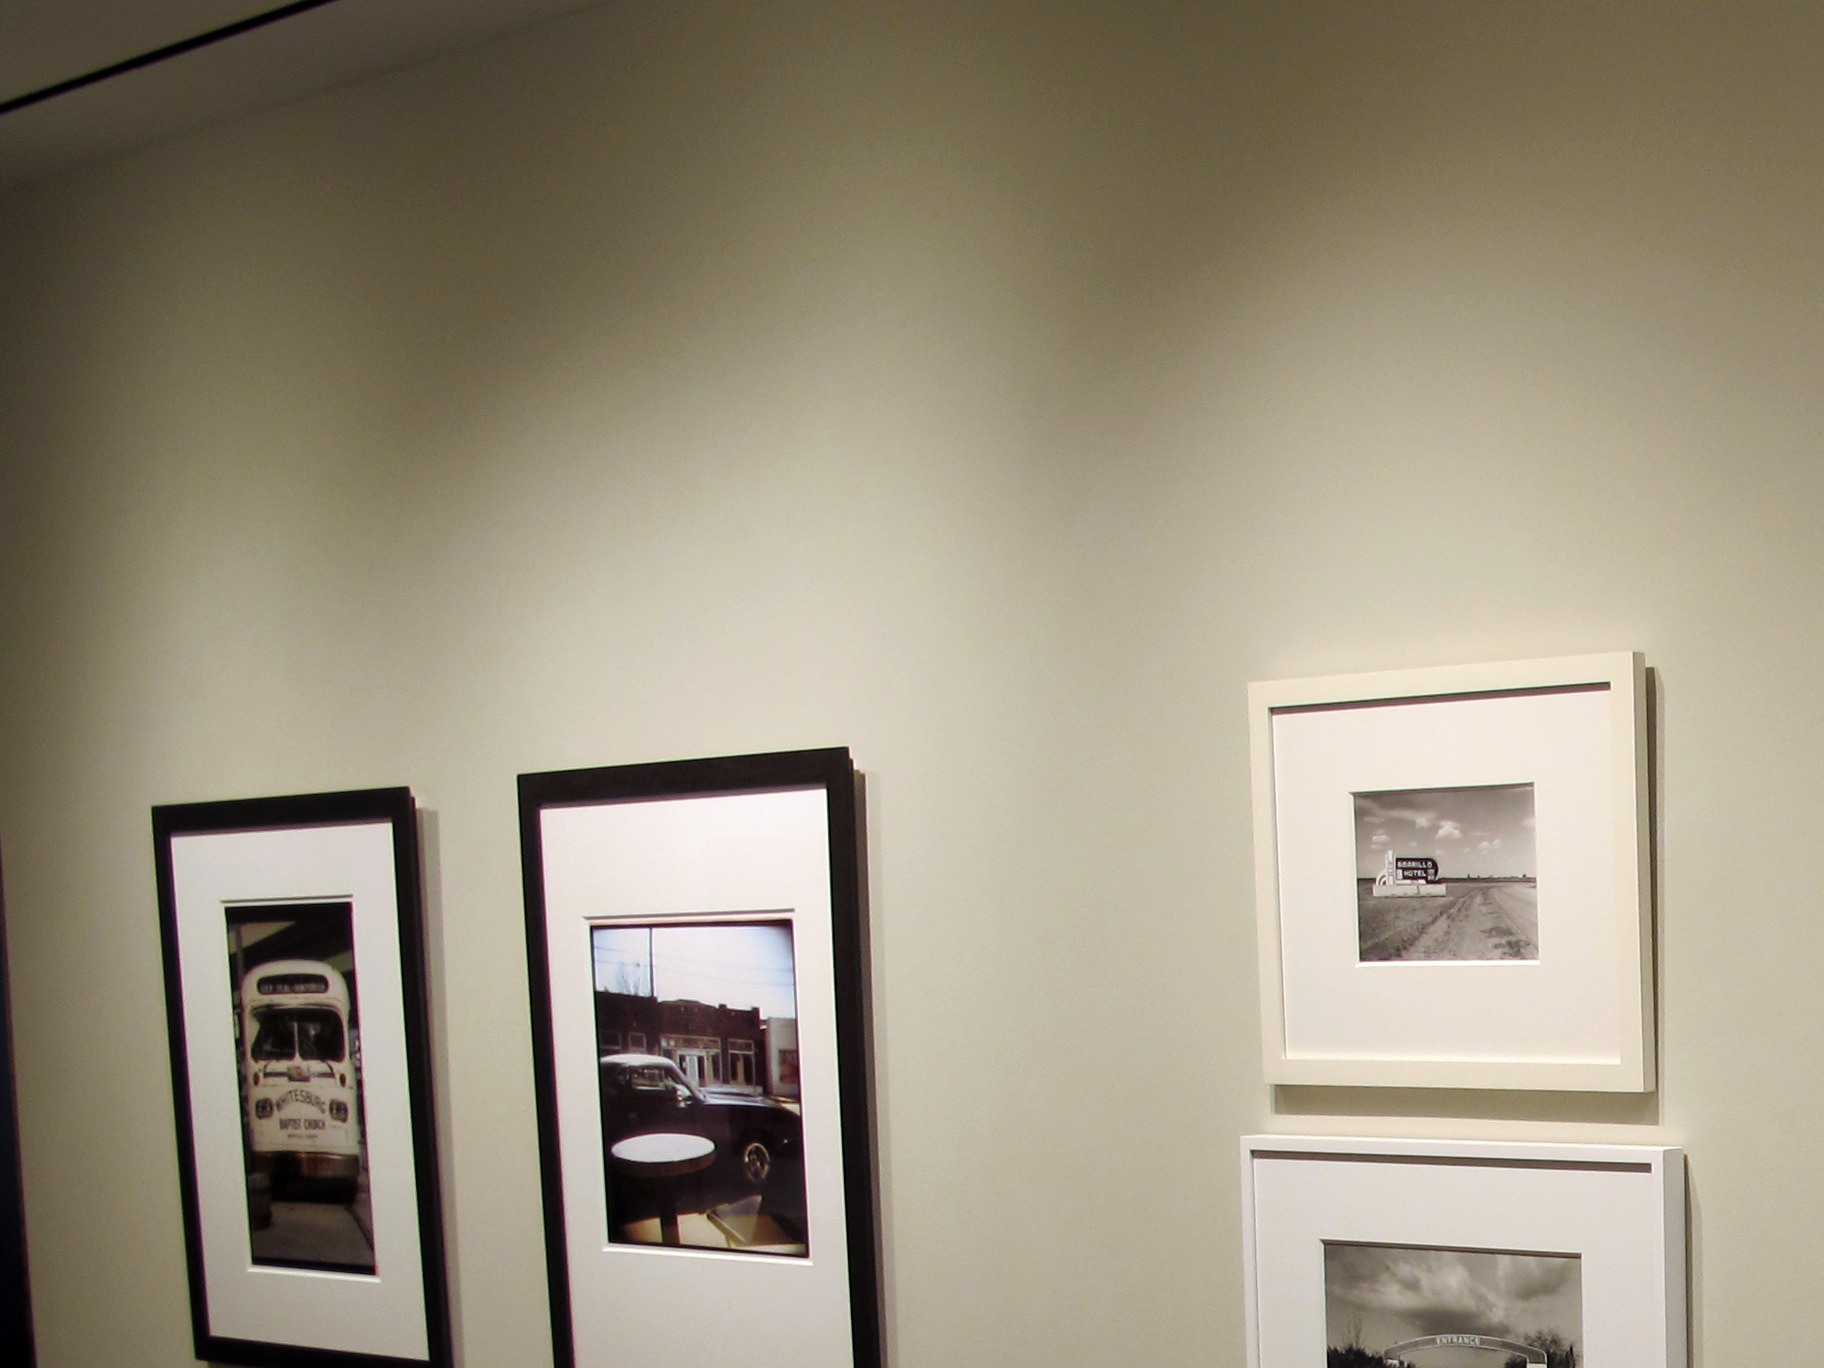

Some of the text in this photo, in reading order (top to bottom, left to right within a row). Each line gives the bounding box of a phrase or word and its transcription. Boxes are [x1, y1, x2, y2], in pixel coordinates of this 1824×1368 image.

[275, 1088, 326, 1114] WHITESBURG
[279, 1118, 326, 1130] BAPTIST CHURCH
[1436, 1335, 1480, 1345] ENTRANCE
